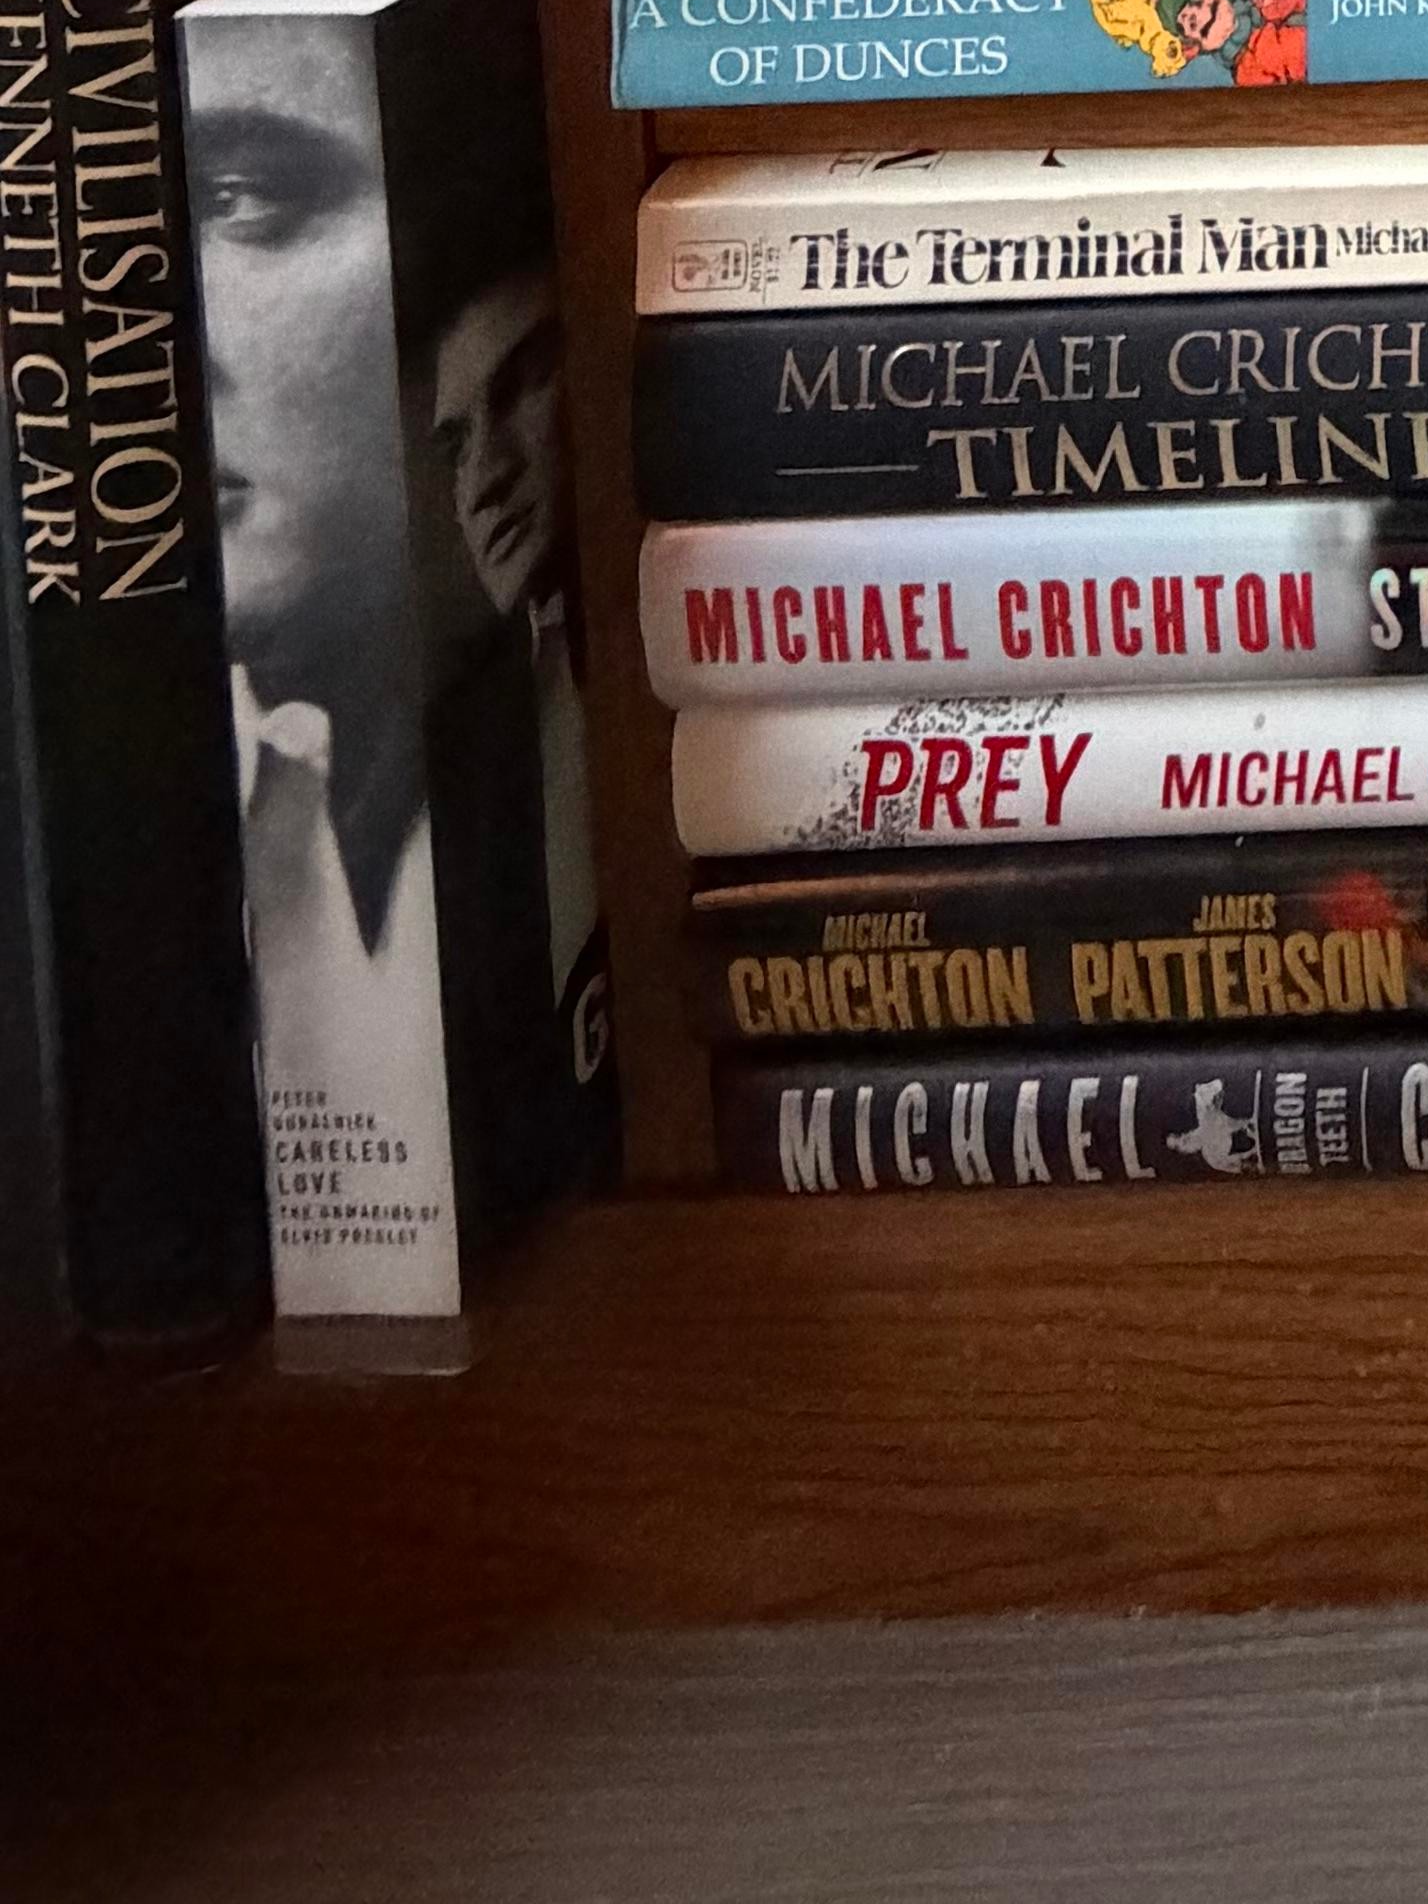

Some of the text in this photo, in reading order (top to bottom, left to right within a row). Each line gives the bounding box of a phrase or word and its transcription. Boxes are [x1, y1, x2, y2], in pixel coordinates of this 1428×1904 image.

[709, 34, 1009, 86] OF DUNCES
[776, 335, 1143, 414] MICHAEL
[684, 579, 970, 666] MICHAEL
[997, 569, 1319, 656] CRICHTON
[858, 734, 1092, 830] PREY
[1160, 744, 1418, 811] MICHAEL
